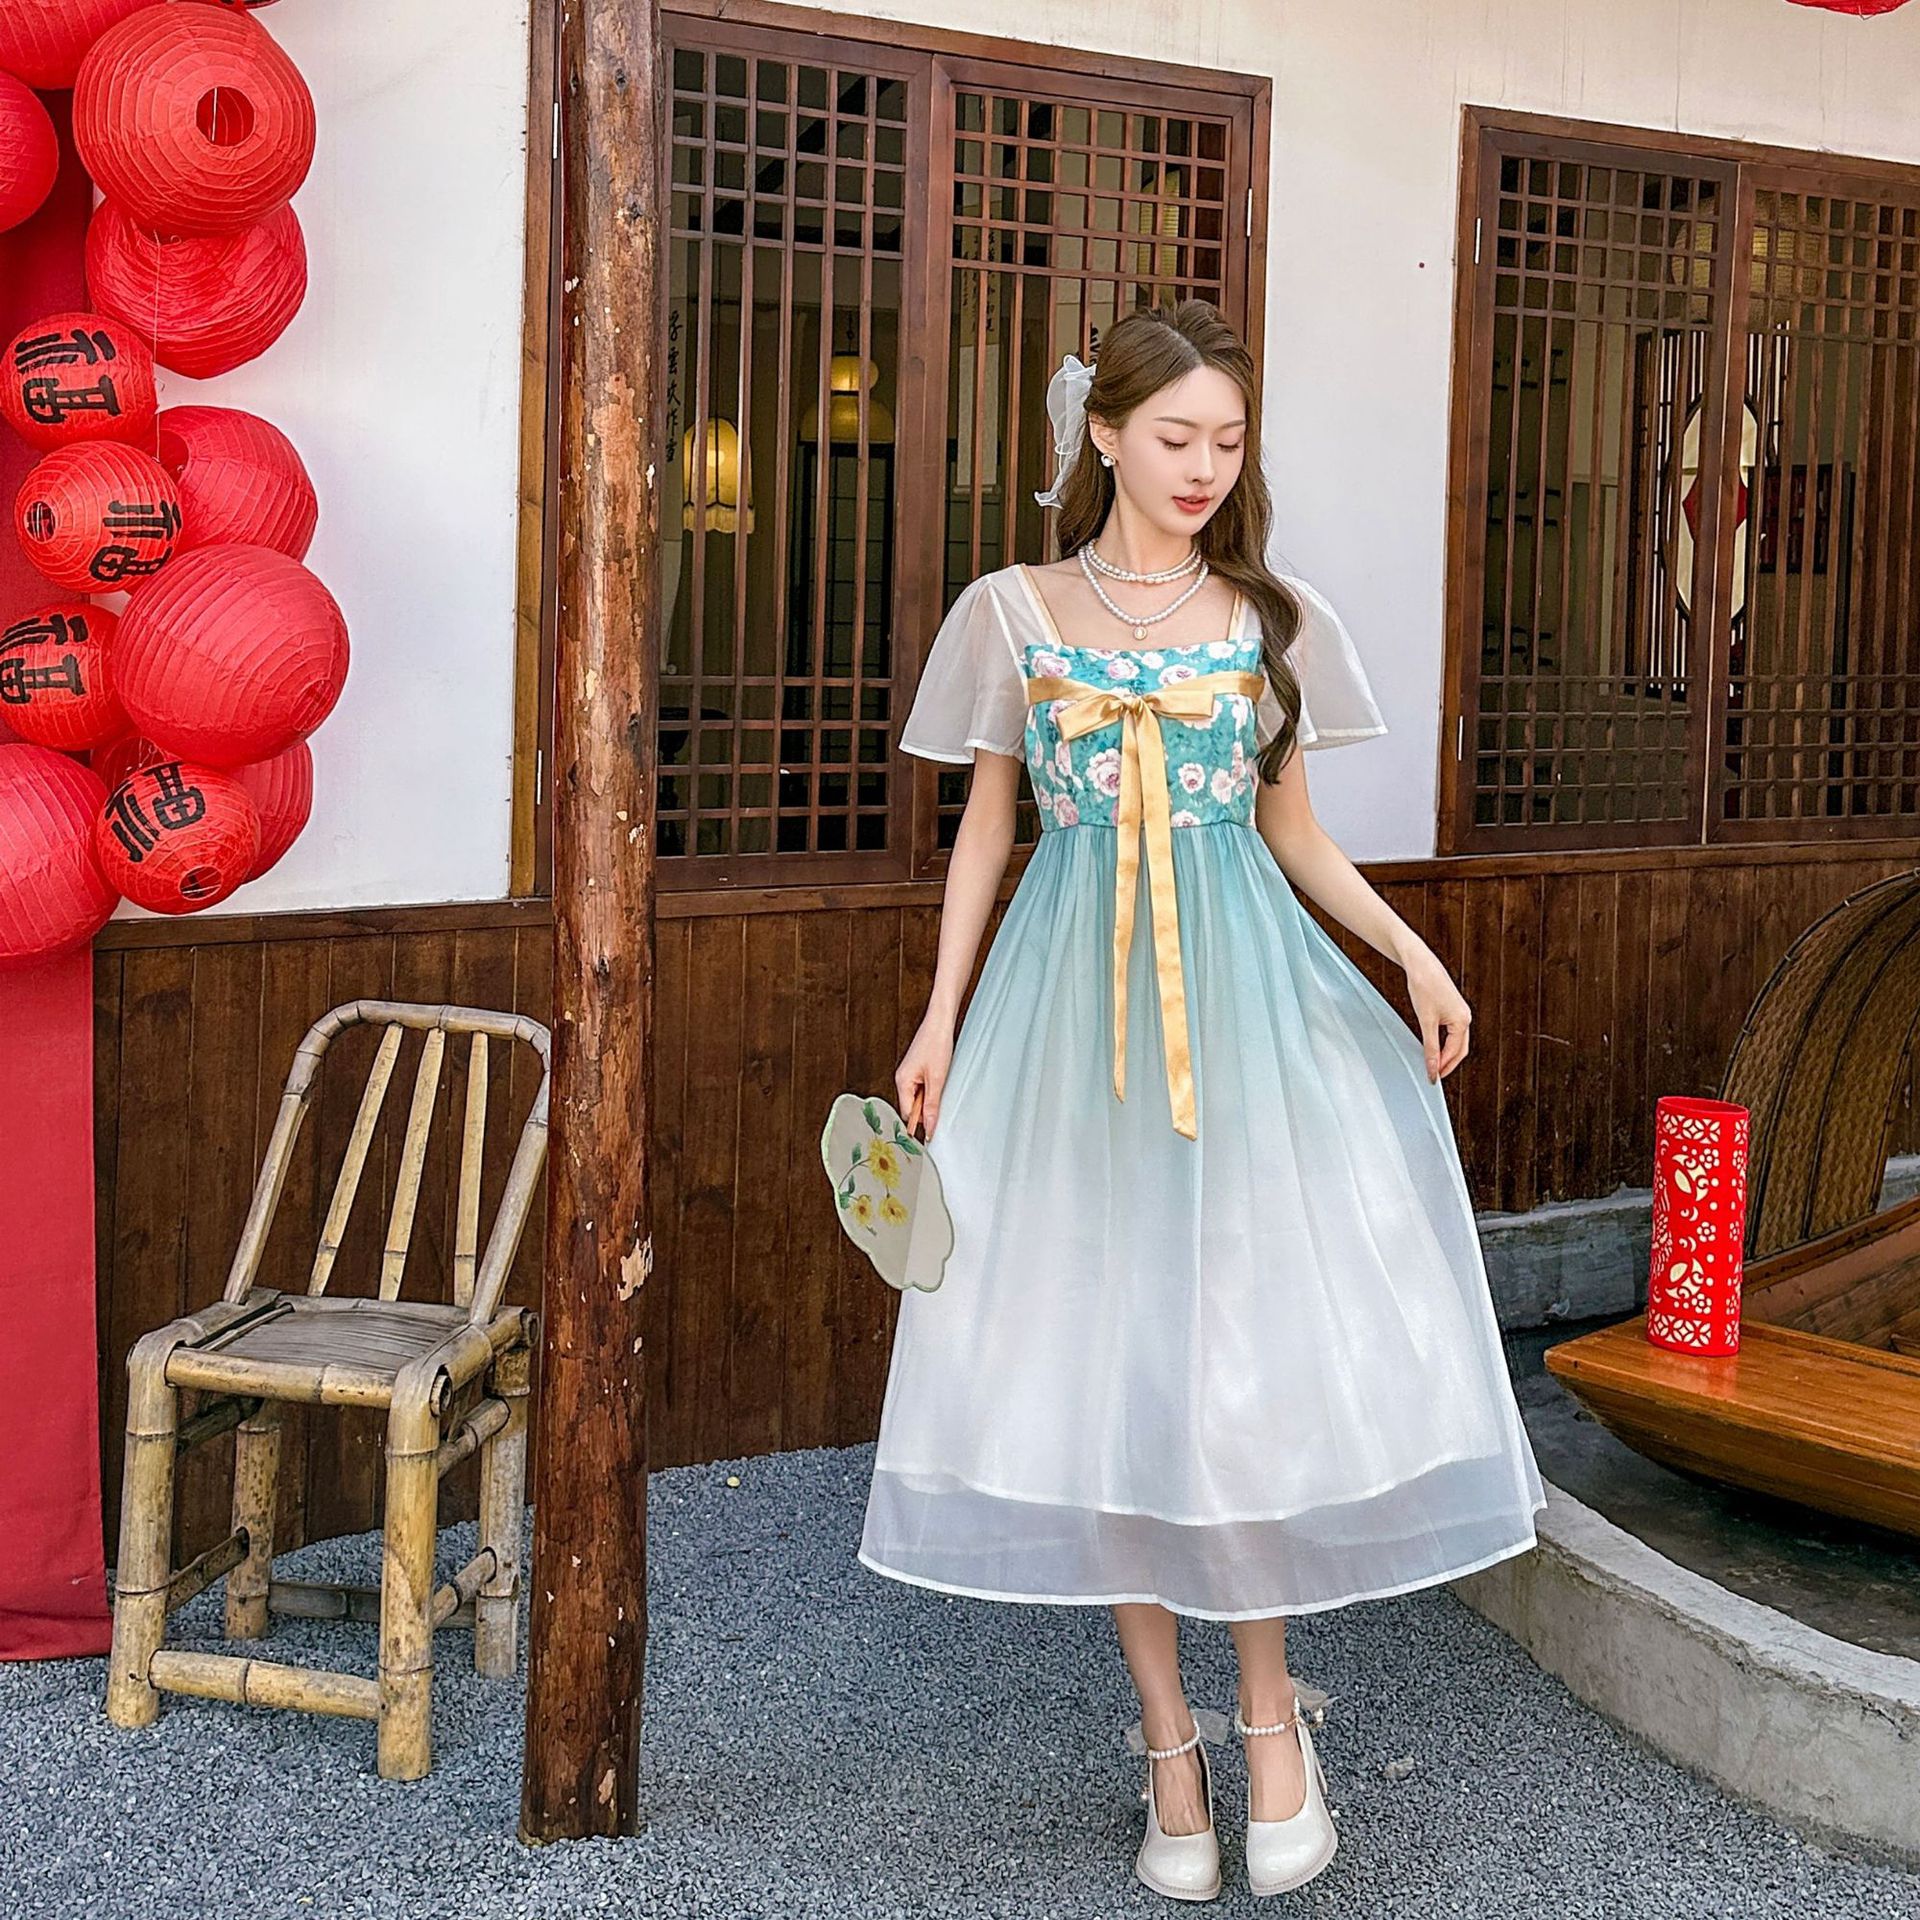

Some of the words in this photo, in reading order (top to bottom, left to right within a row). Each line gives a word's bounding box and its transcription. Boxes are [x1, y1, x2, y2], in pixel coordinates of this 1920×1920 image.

[15, 329, 121, 424] 福
[88, 500, 182, 583] 福
[0, 612, 89, 704] 福
[104, 760, 206, 862] 福
